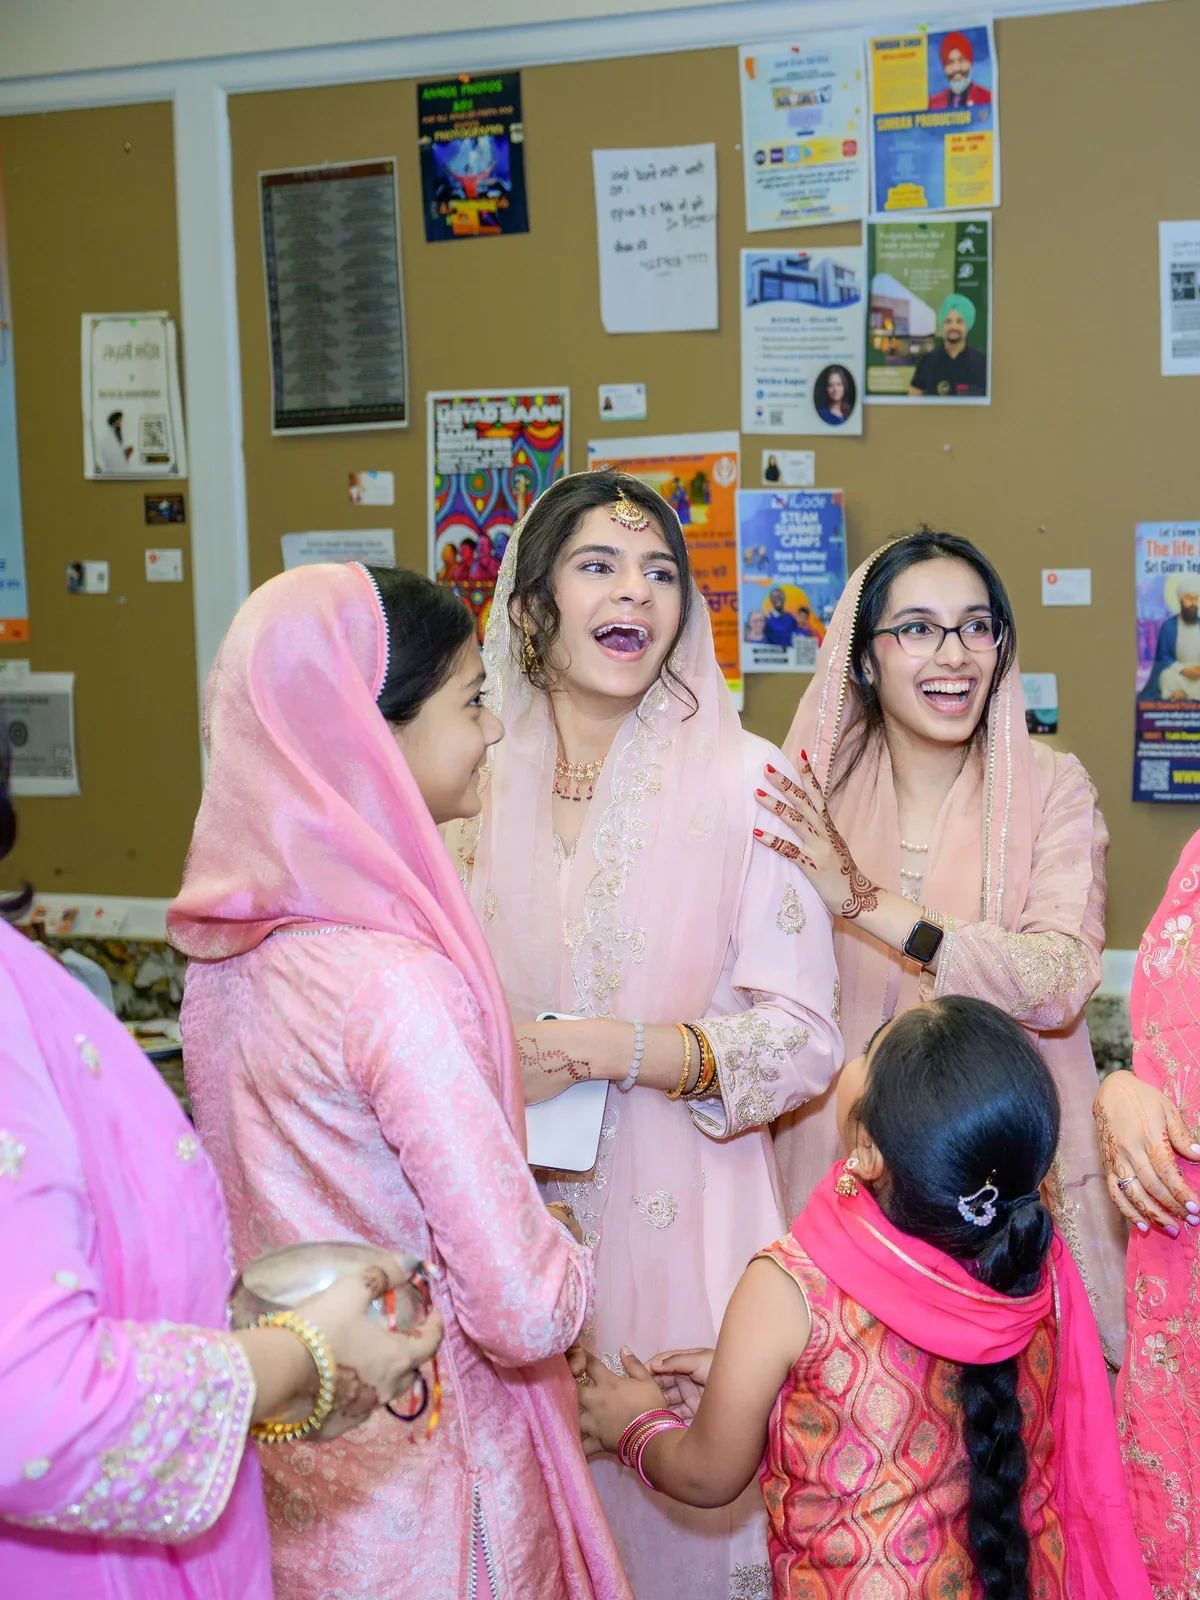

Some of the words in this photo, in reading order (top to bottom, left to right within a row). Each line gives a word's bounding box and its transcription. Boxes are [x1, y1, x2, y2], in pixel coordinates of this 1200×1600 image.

[788, 493, 827, 509] iCode
[780, 510, 819, 524] STEAM
[773, 522, 823, 537] SUMMER
[780, 534, 821, 548] CAMPS
[1146, 539, 1169, 558] The
[1172, 539, 1195, 558] life
[1144, 560, 1159, 573] Sri
[1160, 560, 1185, 573] Guru
